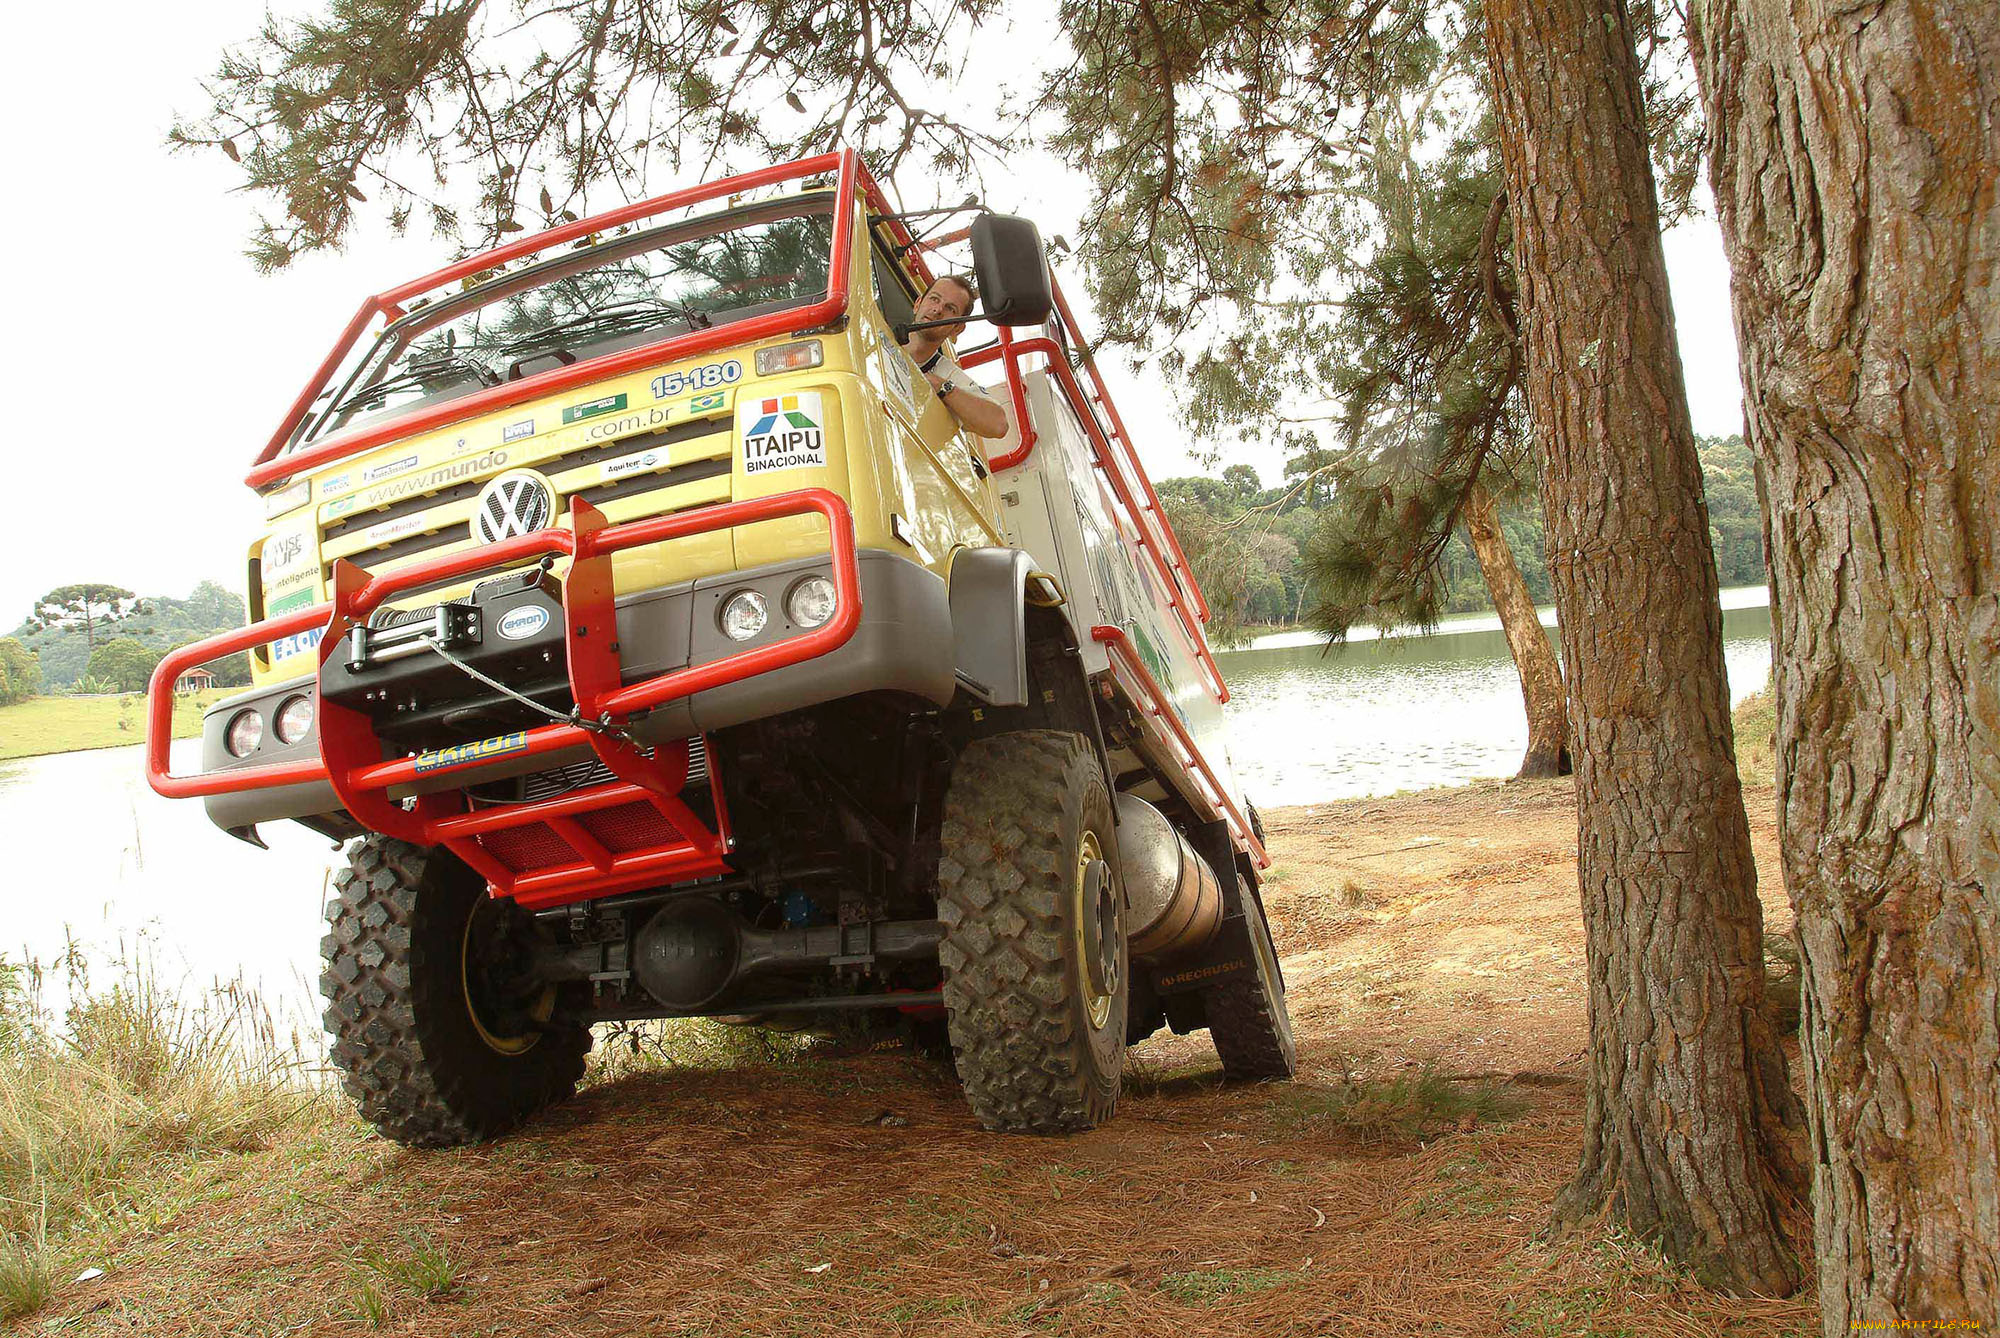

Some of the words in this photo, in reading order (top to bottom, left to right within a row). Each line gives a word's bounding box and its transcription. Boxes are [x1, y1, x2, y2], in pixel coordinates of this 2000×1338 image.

[651, 360, 742, 398] 15-180
[745, 430, 821, 459] ITAIPU
[747, 454, 823, 473] BINACIONAL
[273, 627, 323, 661] EATON
[1176, 958, 1247, 983] RECRUSUL
